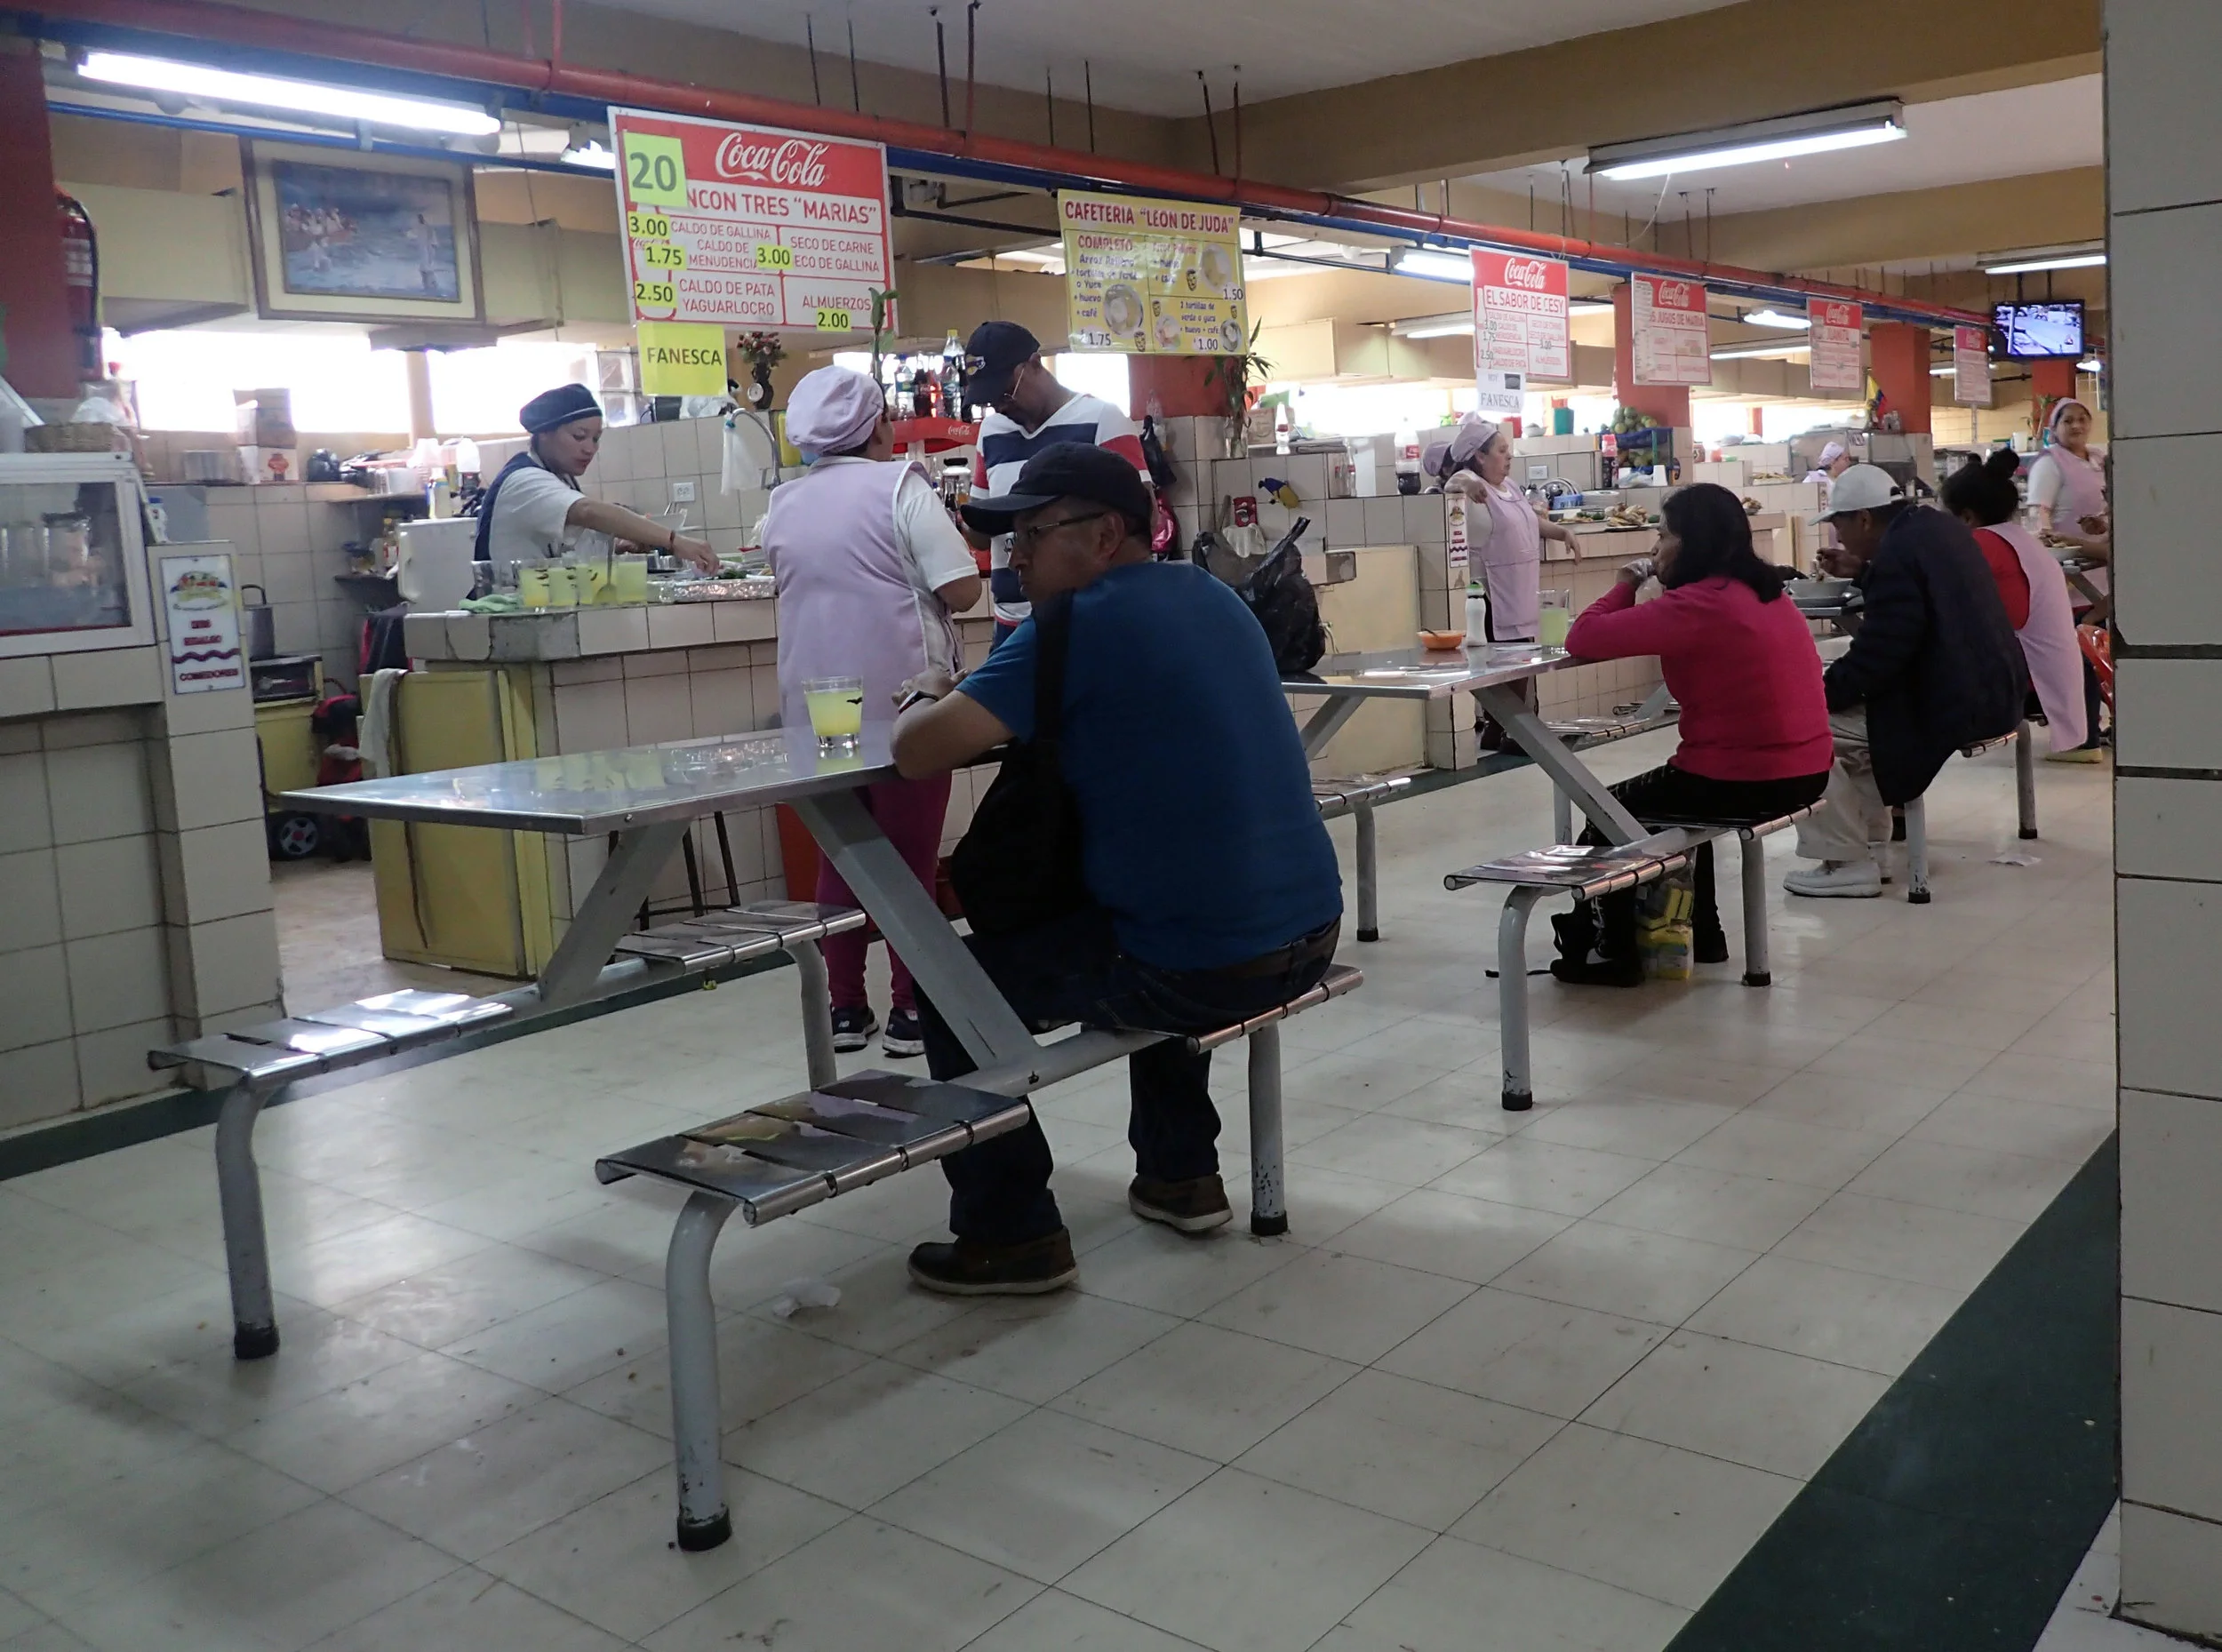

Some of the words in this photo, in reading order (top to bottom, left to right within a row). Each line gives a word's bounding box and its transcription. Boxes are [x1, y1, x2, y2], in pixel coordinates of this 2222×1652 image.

[715, 132, 830, 188] Coca-Cola
[629, 151, 677, 193] 20
[687, 187, 737, 213] NCON
[740, 192, 790, 217] TRES
[793, 195, 876, 224] "MARIAS"
[1066, 201, 1135, 224] CAFETERIA
[1180, 212, 1196, 231] DE
[628, 216, 667, 237] 3.00
[670, 220, 707, 235] CALDO
[709, 224, 724, 237] DE
[726, 225, 771, 240] GALLINA
[697, 238, 733, 251] CALDO
[735, 242, 749, 255] DE
[789, 235, 819, 251] SECO
[821, 238, 837, 252] DE
[838, 240, 875, 255] CARNE
[1077, 235, 1133, 251] COMPLETO
[645, 246, 683, 266] 1.75
[757, 246, 790, 266] 3.00
[793, 254, 816, 268] ECO
[819, 257, 834, 270] DE
[835, 258, 880, 273] GALLINA
[635, 283, 673, 303] 2.50
[679, 278, 723, 294] CALDO
[725, 280, 743, 295] DE
[746, 281, 776, 298] PATA
[1223, 288, 1244, 301] 1.50
[682, 298, 775, 316] YAGUARLOCRO
[802, 294, 871, 311] ALMUERZOS
[1486, 289, 1499, 306] EL
[1499, 291, 1529, 309] SABOR
[1531, 295, 1542, 311] DE
[817, 311, 848, 329] 2.00
[1089, 331, 1112, 347] 1.75
[1198, 338, 1219, 351] 1.00
[646, 347, 723, 366] FANESCA
